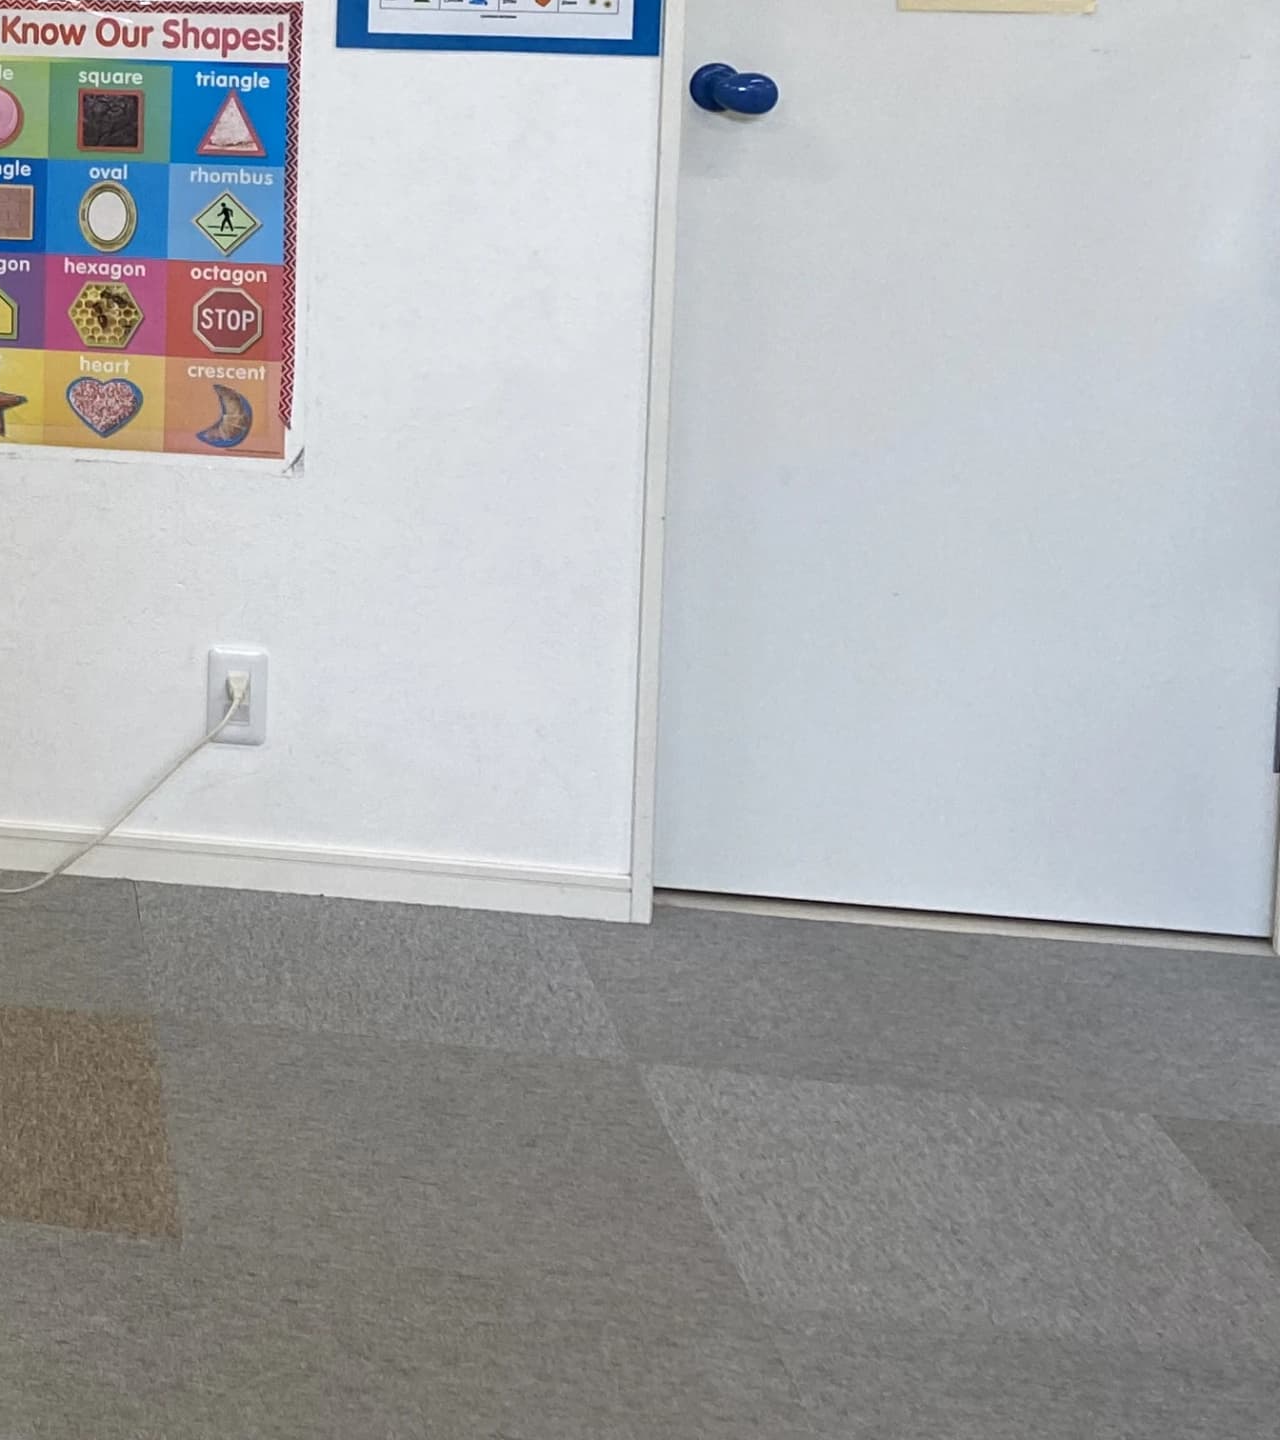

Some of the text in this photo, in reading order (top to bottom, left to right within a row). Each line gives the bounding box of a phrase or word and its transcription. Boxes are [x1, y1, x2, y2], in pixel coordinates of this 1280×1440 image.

[1, 16, 86, 46] Know
[95, 18, 154, 48] Our
[162, 19, 285, 58] Shapes!
[78, 69, 144, 87] square
[195, 71, 270, 92] triangle
[89, 164, 128, 181] oval
[189, 167, 274, 186] rhombus
[64, 259, 146, 280] hexagon
[190, 266, 268, 285] octagon
[200, 307, 255, 330] STOP
[79, 357, 130, 374] heart
[188, 364, 266, 381] crescent
